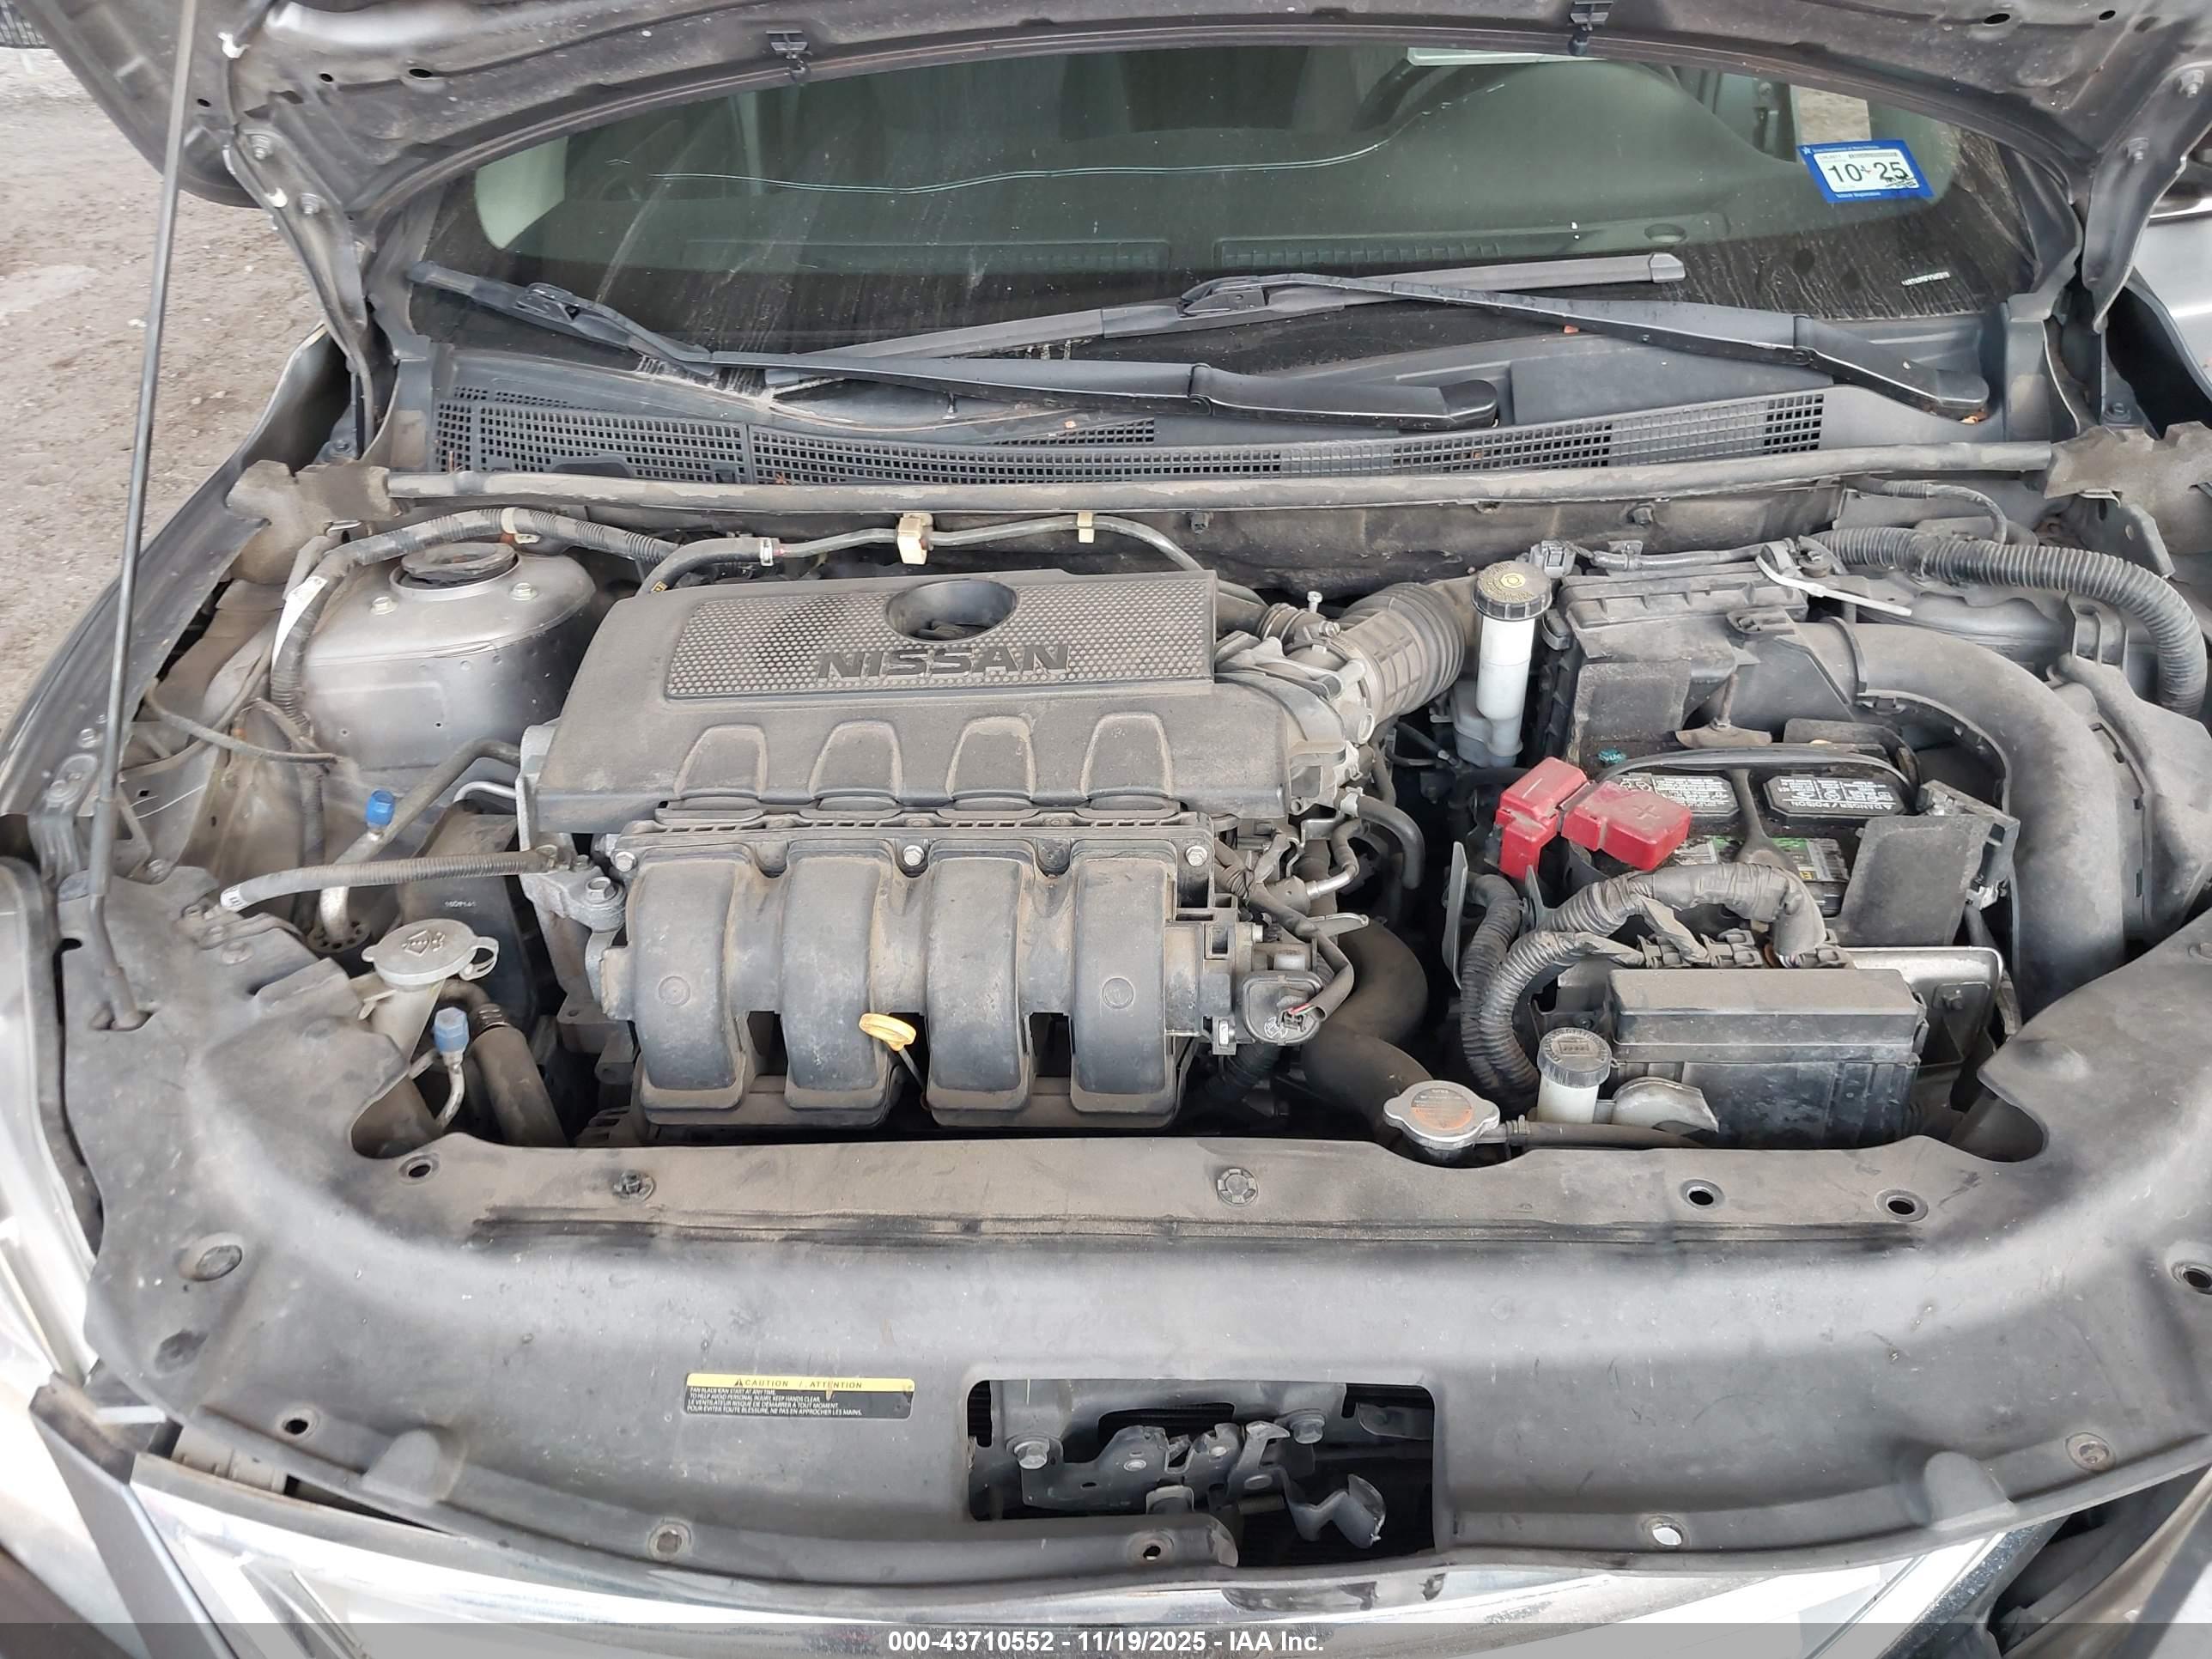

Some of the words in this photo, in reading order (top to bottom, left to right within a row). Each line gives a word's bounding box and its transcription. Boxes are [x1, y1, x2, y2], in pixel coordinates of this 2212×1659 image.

[1828, 163, 1863, 183] 10
[1874, 161, 1908, 179] 25
[816, 645, 1071, 679] NISSAN
